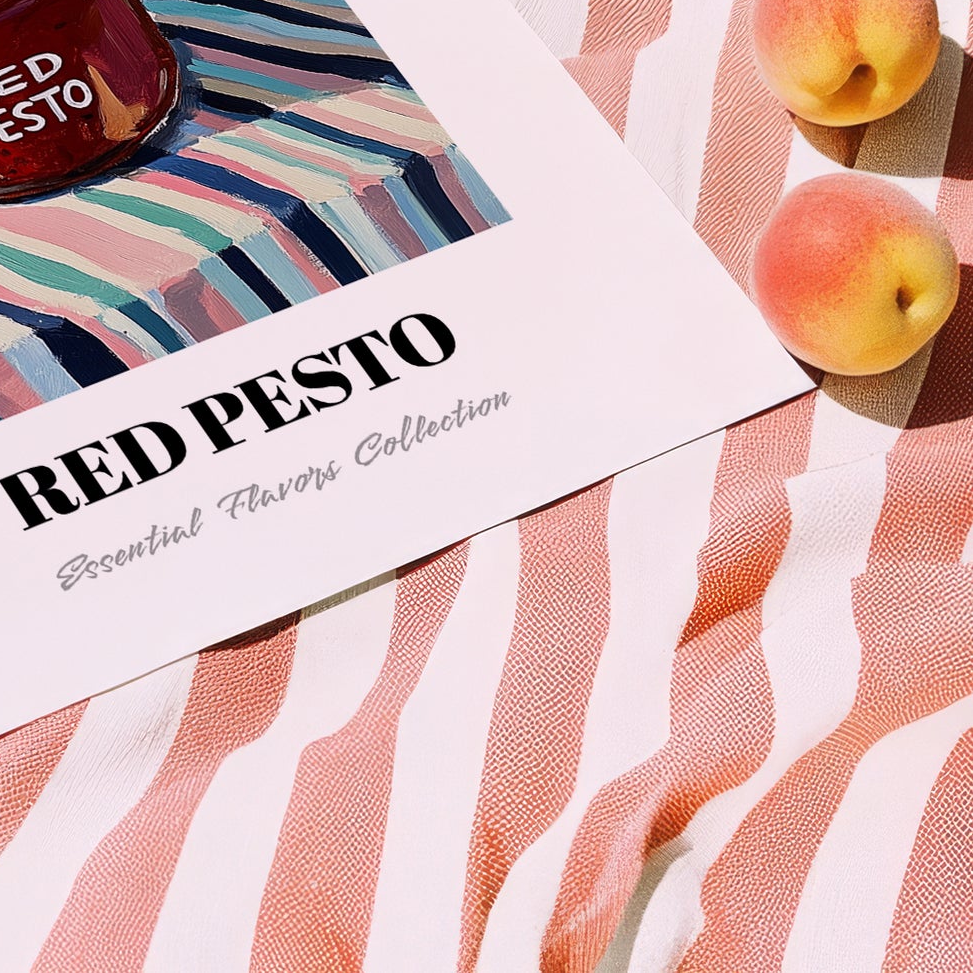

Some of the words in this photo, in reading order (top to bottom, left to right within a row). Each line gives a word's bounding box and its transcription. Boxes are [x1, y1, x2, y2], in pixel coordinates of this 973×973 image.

[181, 313, 456, 454] PESTO
[56, 507, 204, 591] Essential
[217, 459, 342, 520] Flavors
[354, 391, 512, 467] Collection
